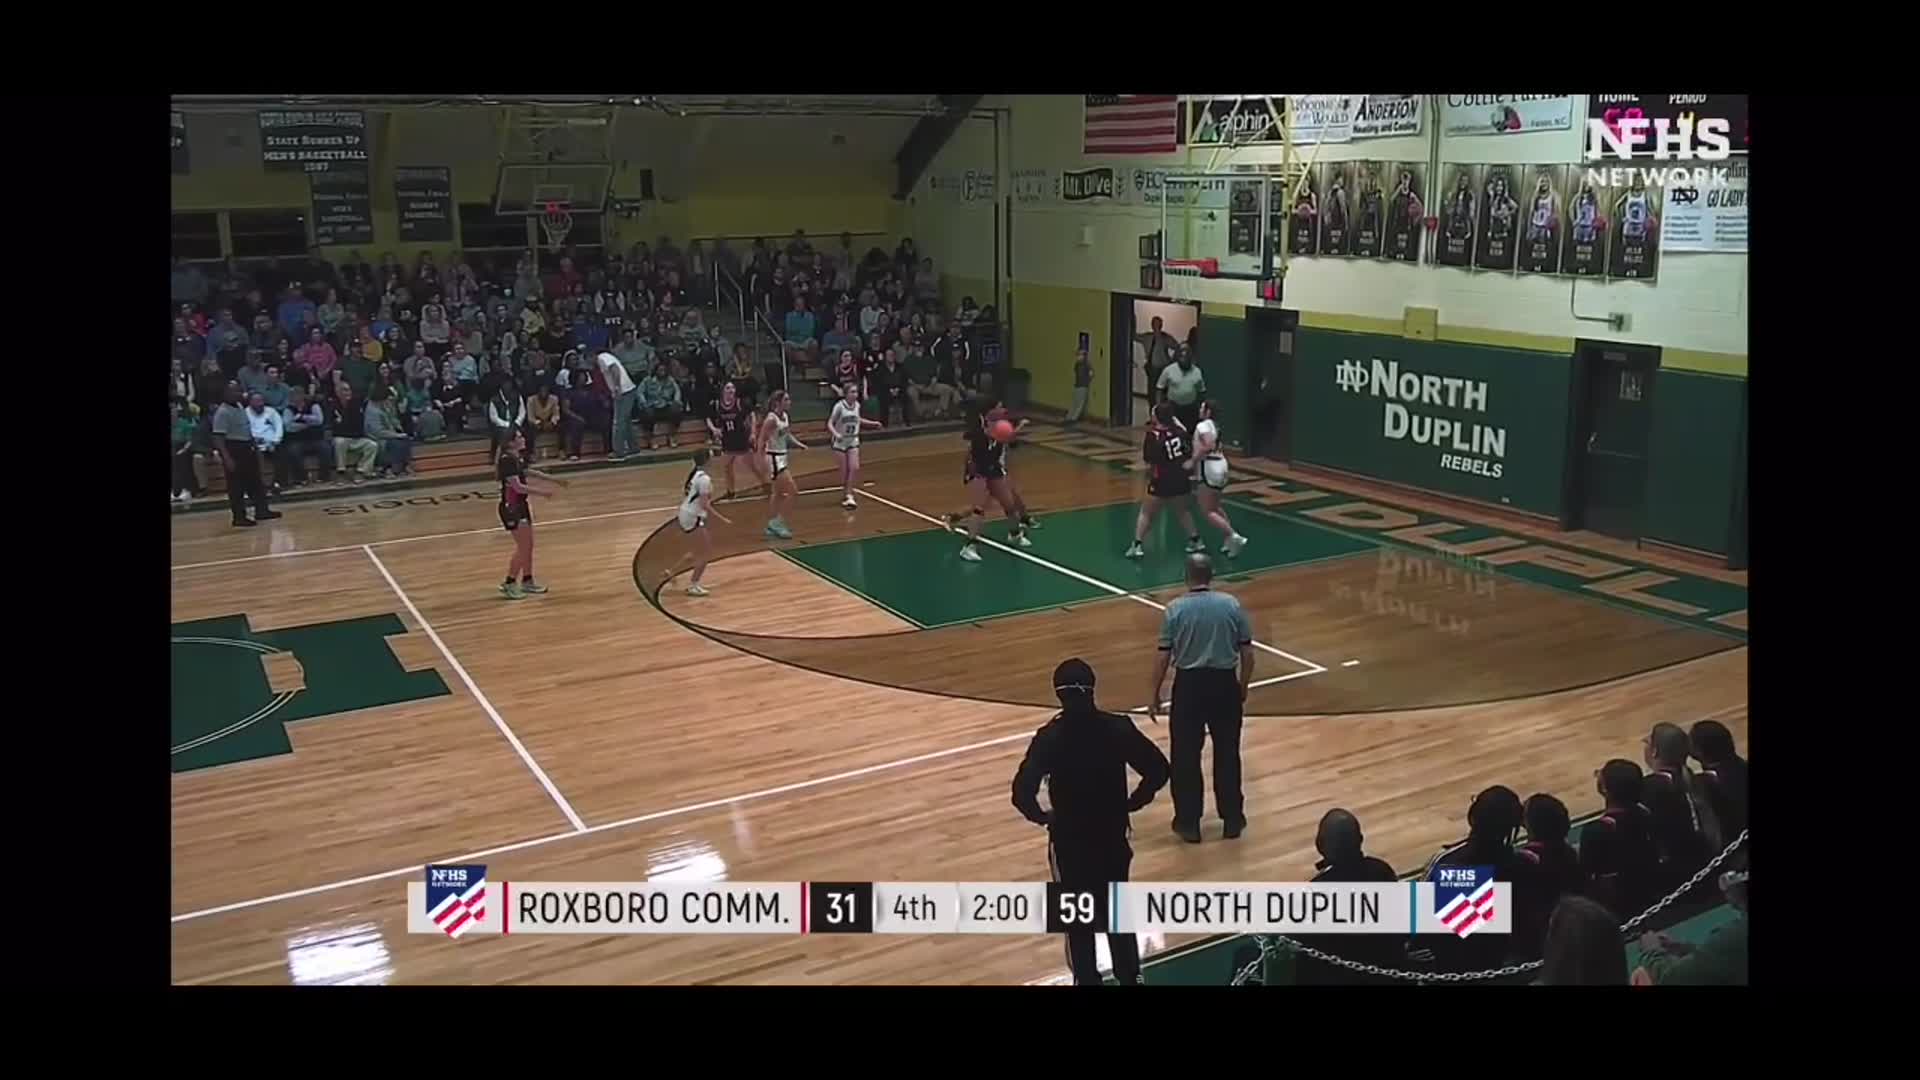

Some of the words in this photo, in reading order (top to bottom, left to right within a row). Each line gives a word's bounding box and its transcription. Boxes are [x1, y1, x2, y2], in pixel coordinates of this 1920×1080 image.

[1355, 96, 1418, 121] ANDERSON
[1371, 359, 1487, 412] NORTH
[1384, 402, 1506, 458] DUPLIN
[1165, 437, 1183, 460] 12
[1441, 454, 1503, 479] REBELS
